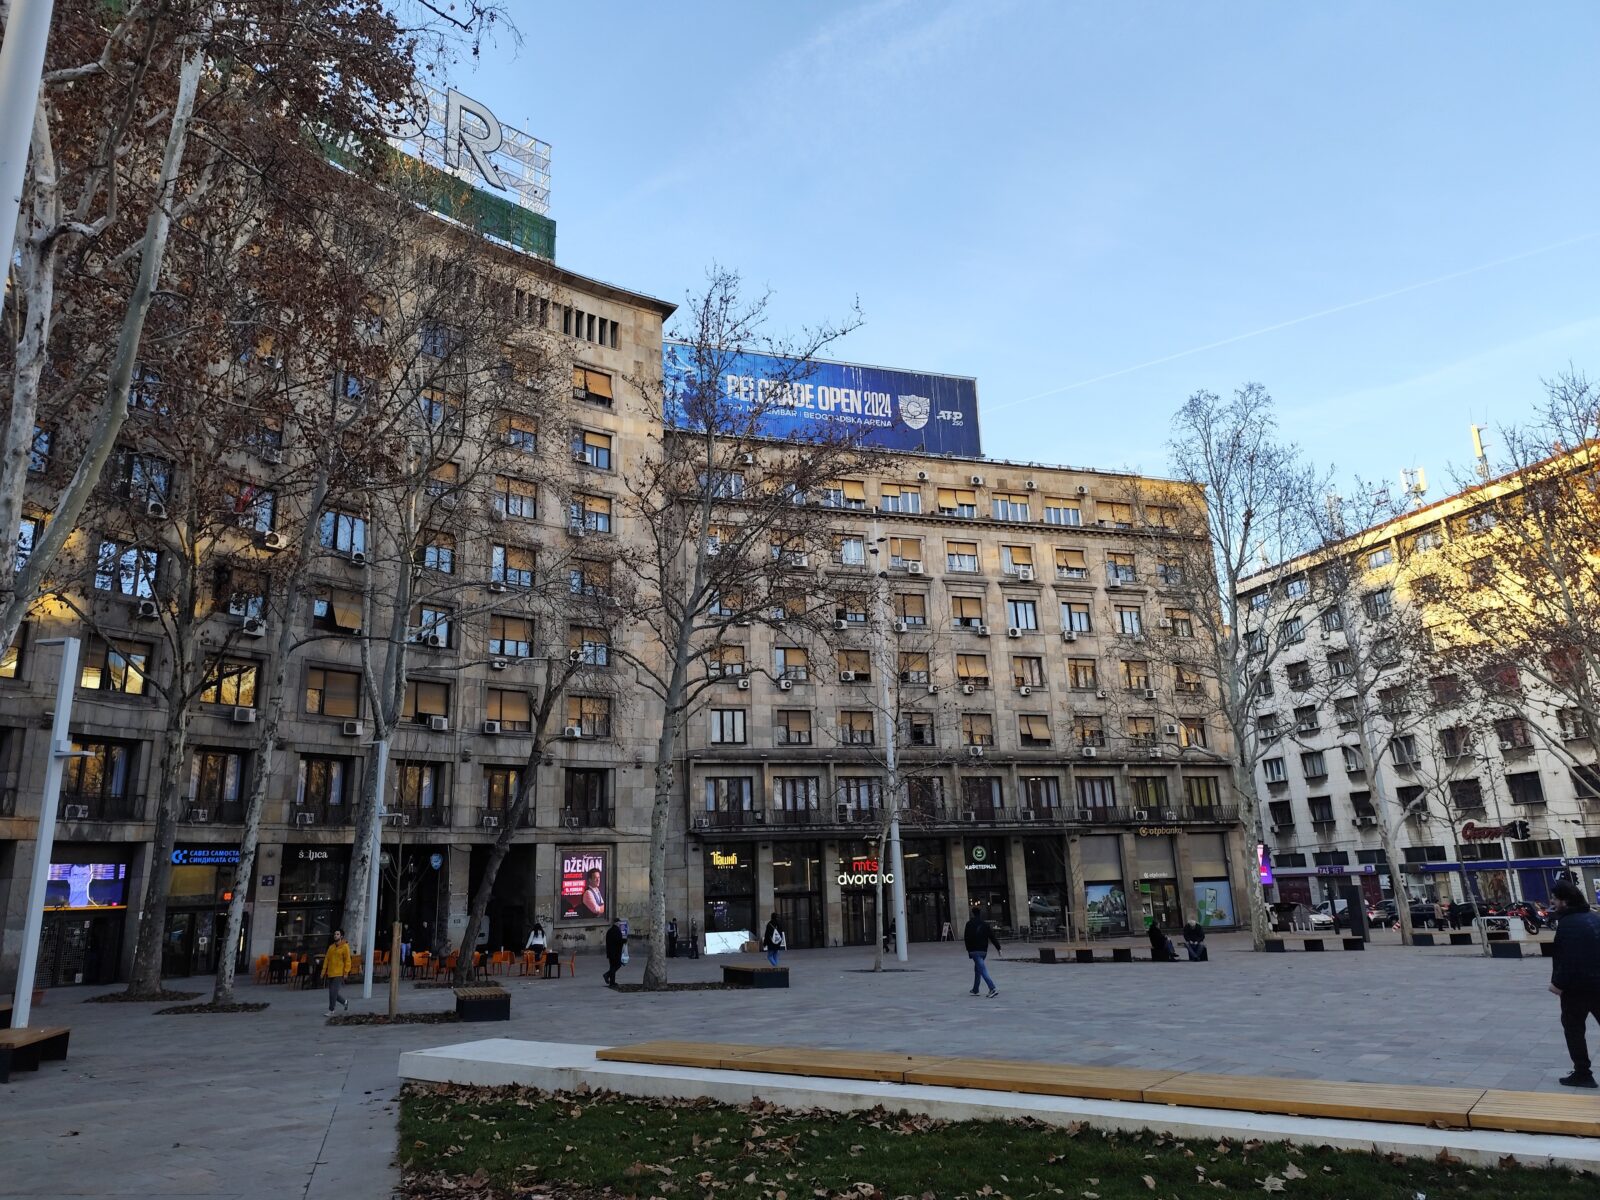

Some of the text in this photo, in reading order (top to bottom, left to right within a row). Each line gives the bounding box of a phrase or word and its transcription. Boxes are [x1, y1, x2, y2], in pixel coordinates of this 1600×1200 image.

[817, 385, 862, 413] OPEN
[864, 391, 893, 418] 2024
[746, 405, 797, 417] NEMBAR
[863, 417, 892, 427] ARENA
[937, 410, 963, 420] ATP
[952, 419, 964, 427] 250
[563, 856, 603, 873] DŽENAN
[852, 859, 879, 872] mts
